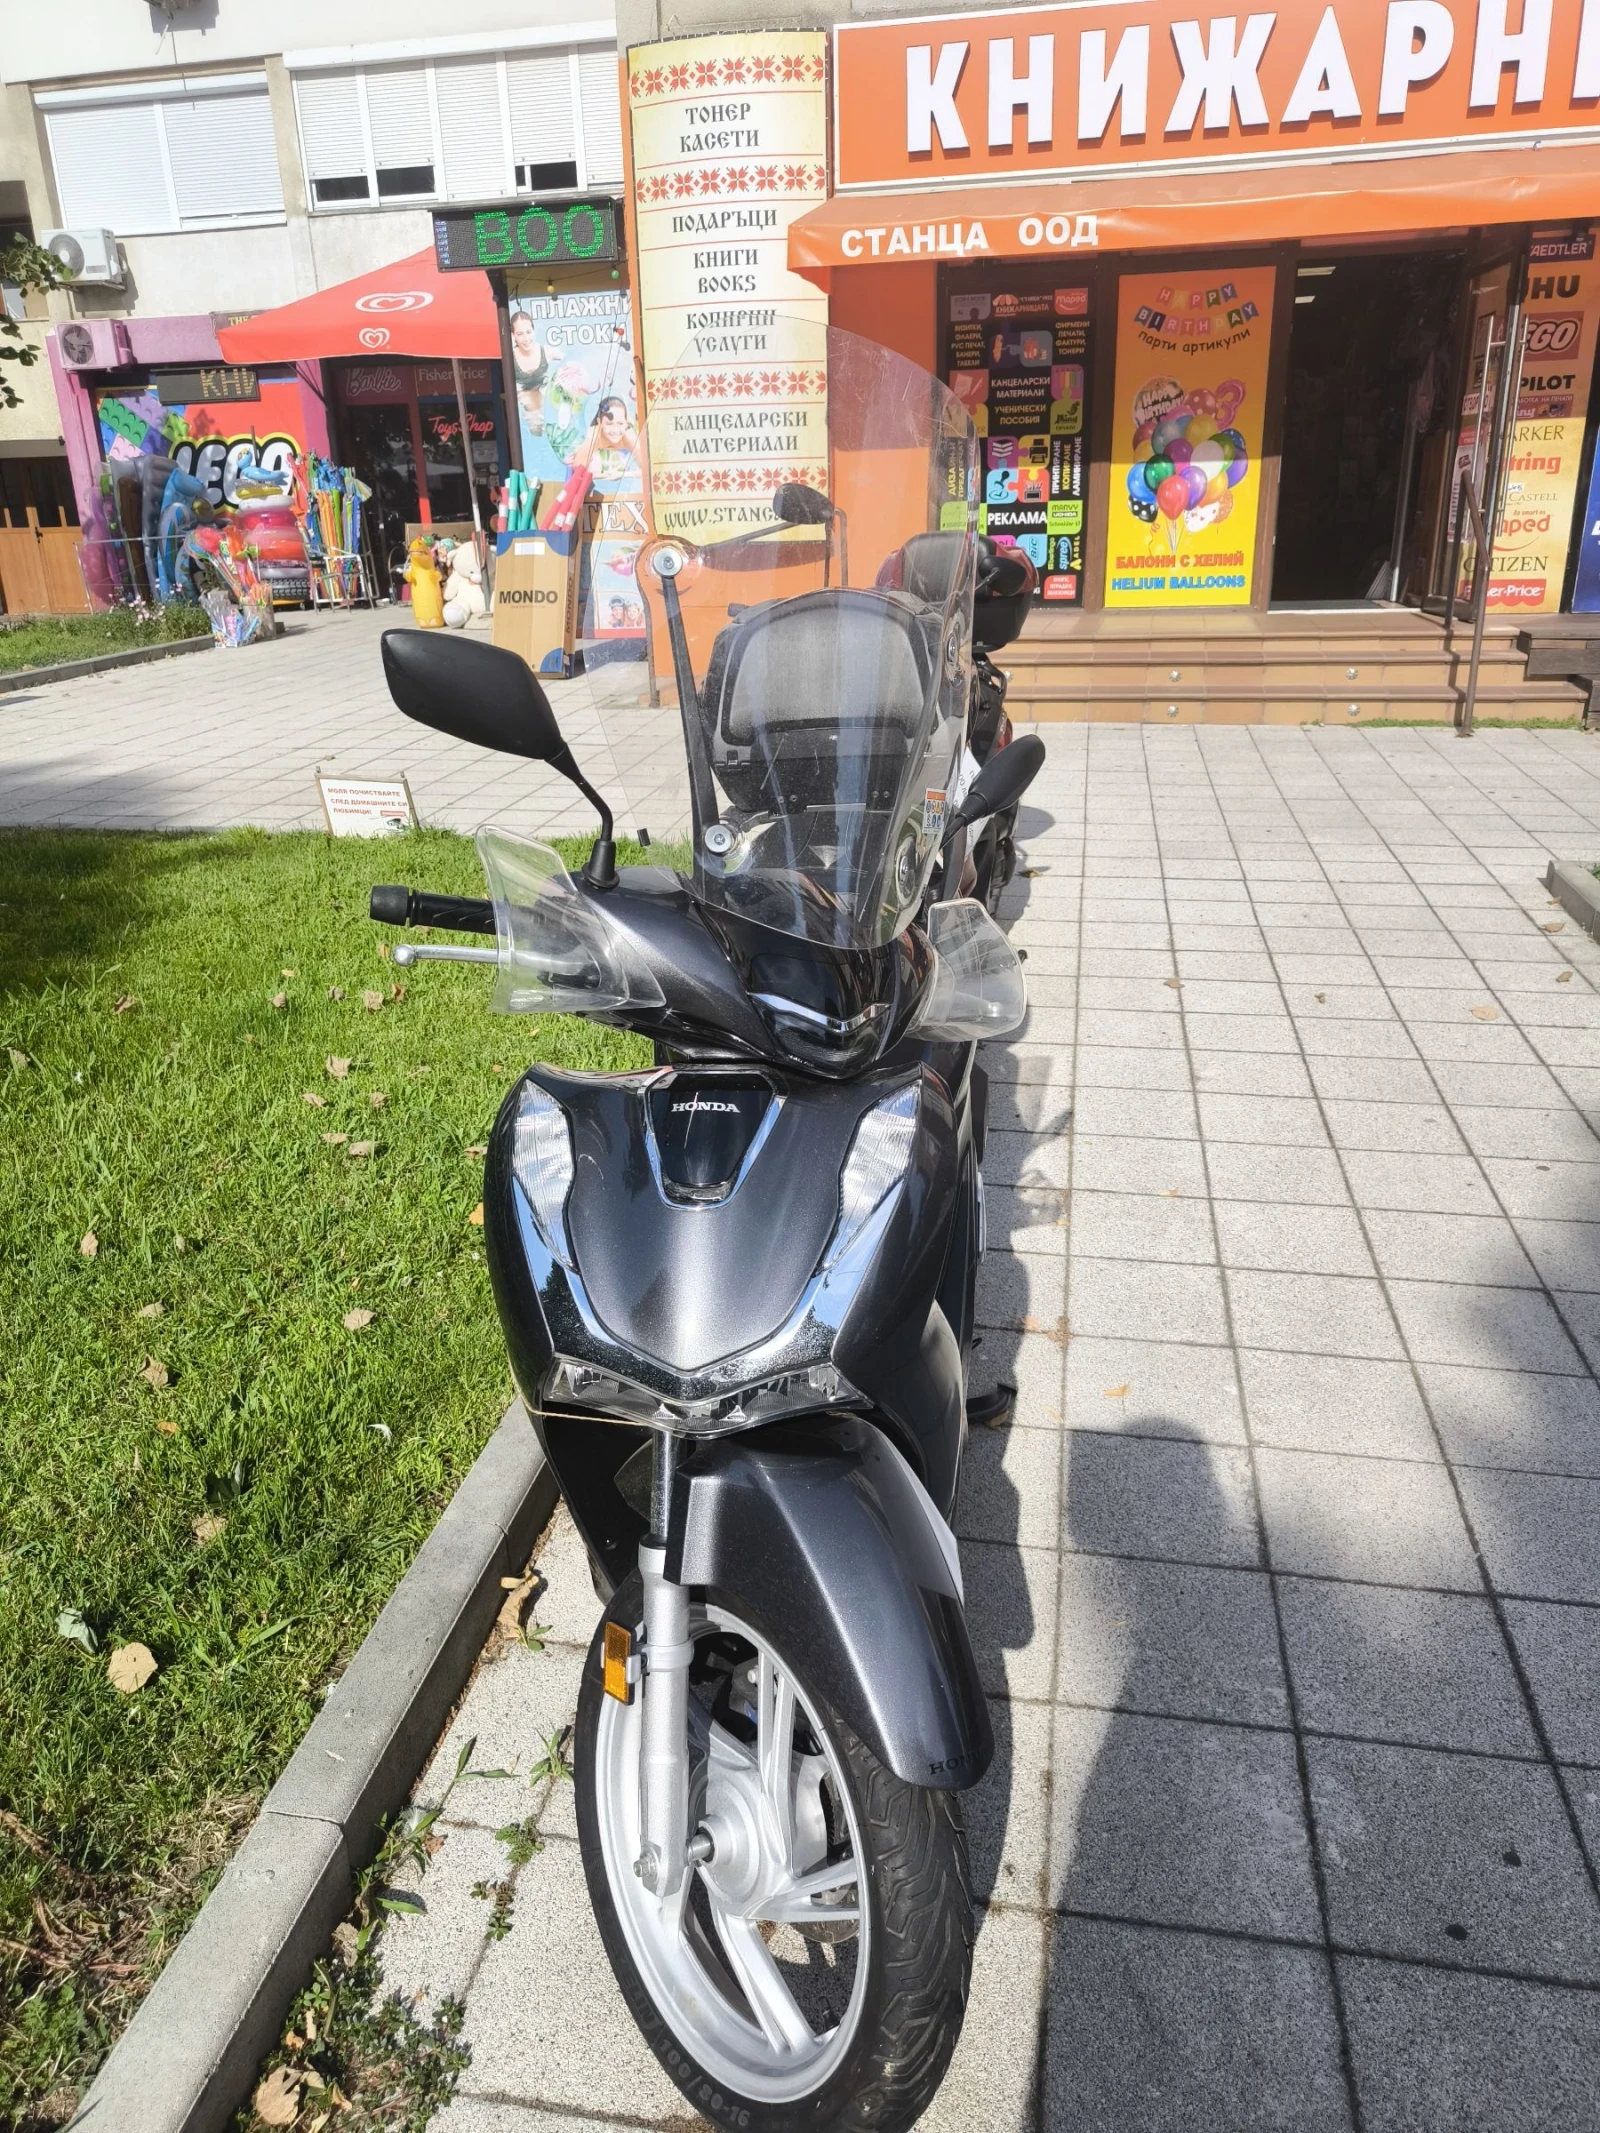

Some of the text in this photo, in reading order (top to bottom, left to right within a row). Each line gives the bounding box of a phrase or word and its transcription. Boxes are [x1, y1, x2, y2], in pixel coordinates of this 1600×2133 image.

[685, 102, 751, 125] ТОНЕР
[680, 129, 760, 153] КАСЕТИ
[672, 209, 778, 234] ПОДАРЪЦИ
[841, 215, 1099, 259] СТАНЦА ООД
[693, 248, 759, 269] КНИГИ
[1530, 242, 1588, 257] AEDTLER
[697, 274, 757, 294] BOOKS
[1525, 275, 1581, 300] HU
[1160, 285, 1233, 306] HAPPY
[686, 309, 777, 330] КОПИРНИ
[1138, 304, 1254, 331] BIRTHDAY
[546, 322, 628, 347] СТОКИ
[1138, 329, 1251, 356] парти артикули
[694, 334, 767, 358] УСЛУГИ
[346, 367, 401, 397] Barbie
[418, 366, 487, 382] Fisherrice
[991, 377, 1050, 388] КАНЦЕЛАРСКИ
[996, 388, 1045, 399] МАТЕРИАЛИ
[995, 404, 1047, 415] УЧЕНИЧЕСКИ
[1000, 415, 1040, 425] ПОСОБИЯ
[673, 411, 809, 433] КАНЦЕЛАРСКИ
[1504, 425, 1565, 441] ARKER
[682, 435, 799, 455] МАТЕРИАЛИ
[1052, 440, 1061, 494] ПРИНТИРАНЕ
[1062, 443, 1071, 490] КОПИРАНЕ
[1072, 436, 1082, 496] ЛАМИНИРАНЕ
[1508, 492, 1558, 502] CASTELL
[987, 512, 1047, 526] РЕКЛАМА
[1496, 515, 1551, 537] aped
[1115, 550, 1245, 569] БАЛОНИ С ХЕЛИЙ
[1463, 556, 1549, 572] CTIZEN
[1111, 575, 1246, 590] HELIUM BALLOONS
[1463, 584, 1536, 600] Fer-Price
[499, 589, 559, 604] MONDO
[565, 576, 575, 634] MONDO
[670, 1101, 741, 1113] HONDA
